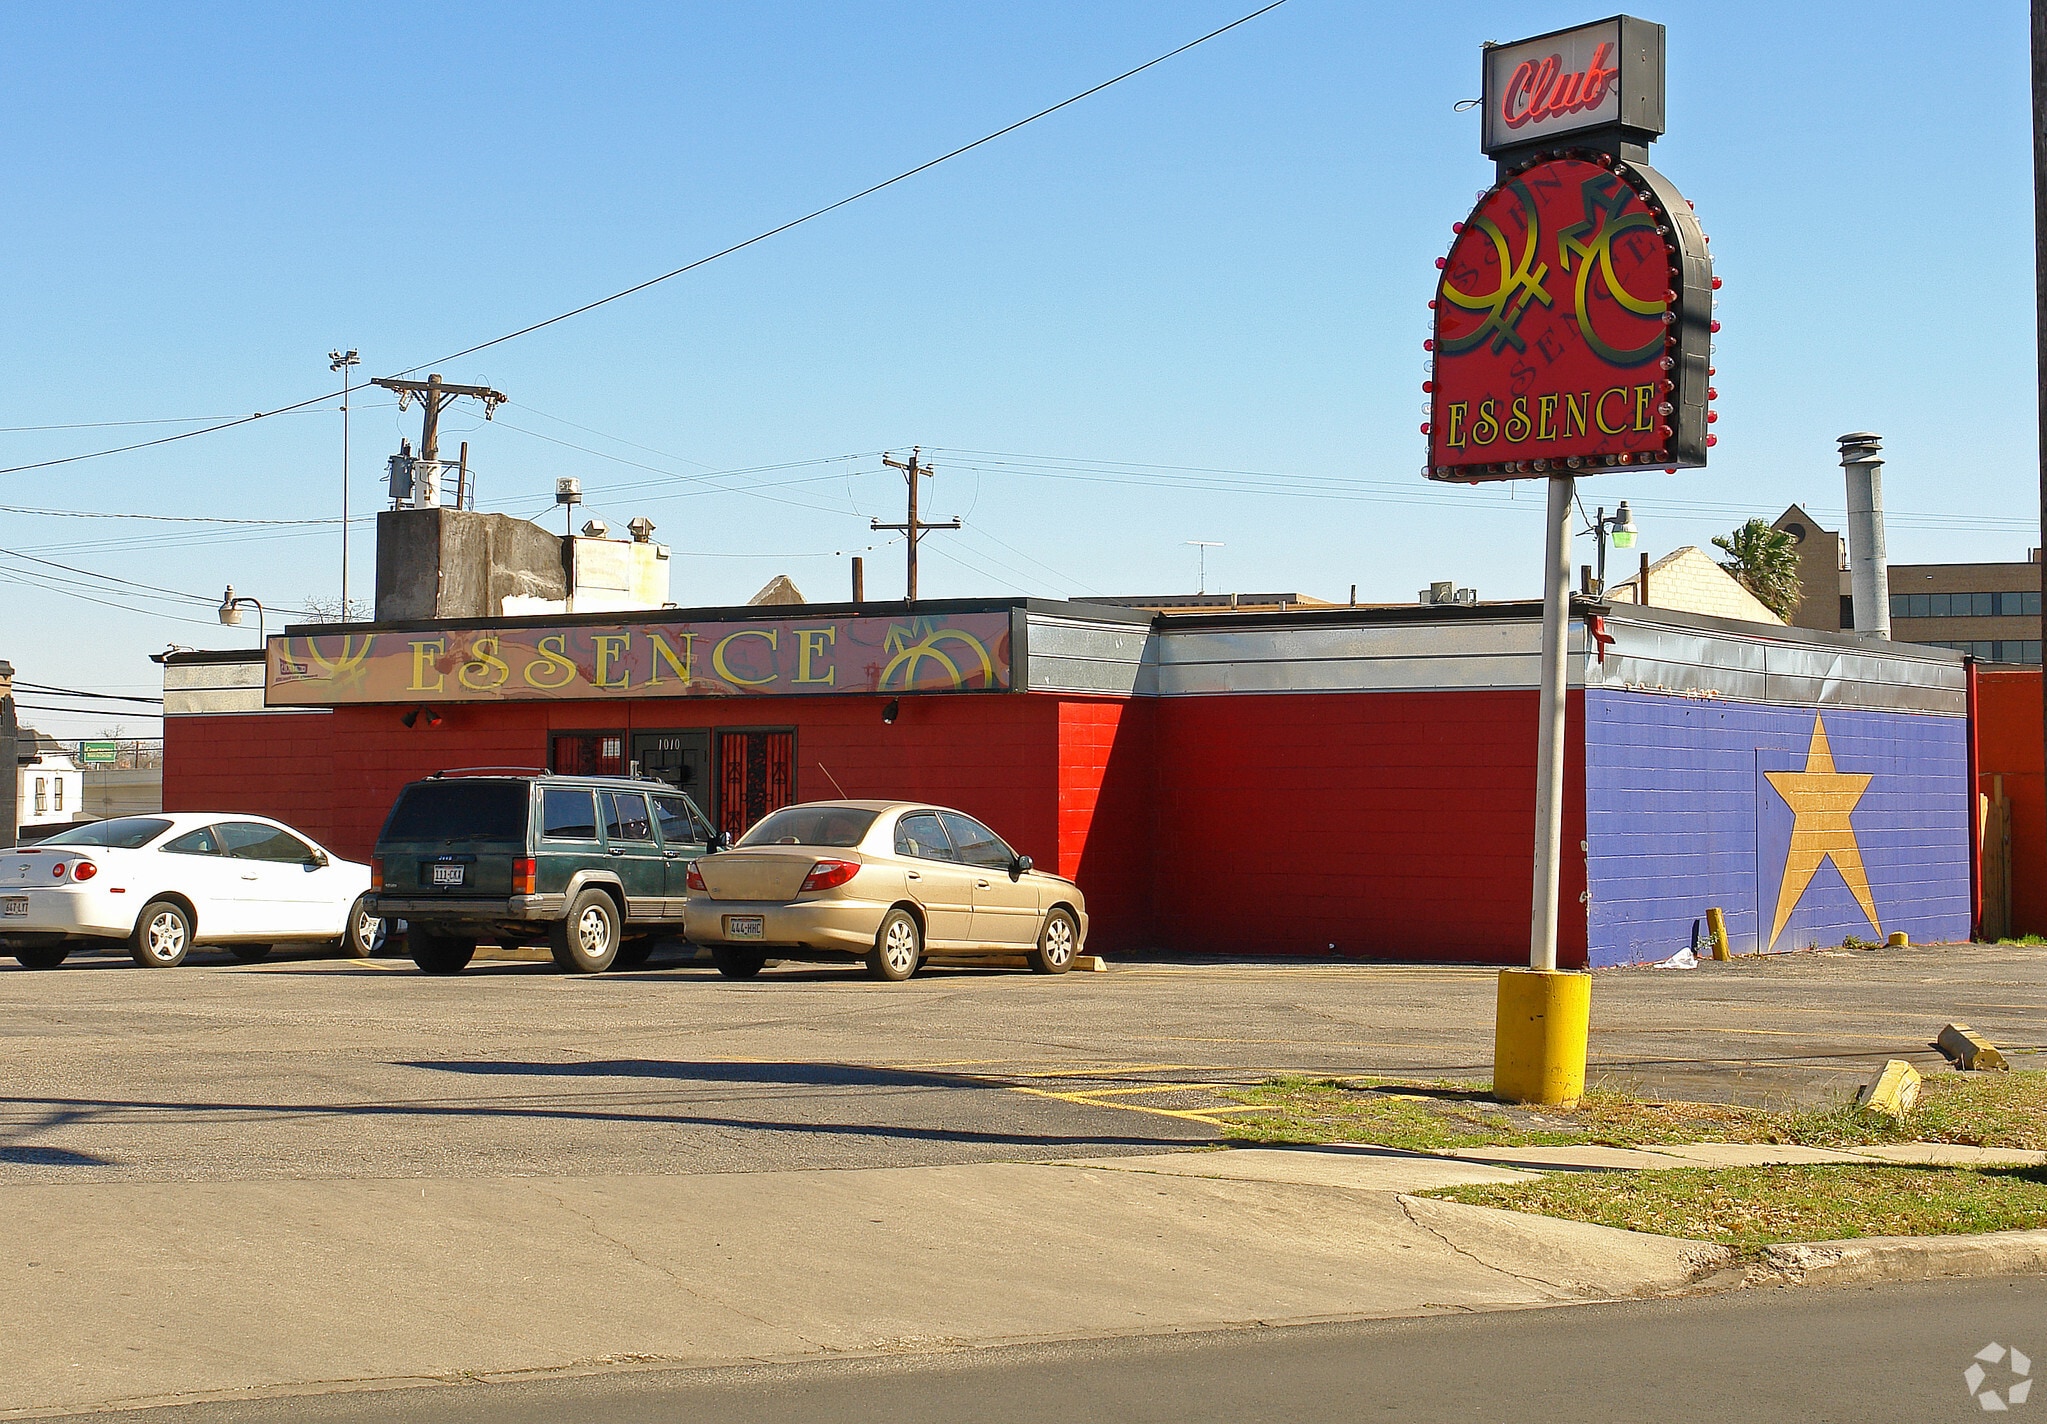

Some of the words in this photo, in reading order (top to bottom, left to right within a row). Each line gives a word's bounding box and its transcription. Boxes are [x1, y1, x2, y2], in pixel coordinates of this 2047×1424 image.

[1502, 42, 1618, 129] Club
[1447, 382, 1656, 449] ESSENCE
[406, 625, 837, 693] ESSENCE
[658, 738, 680, 751] 1010
